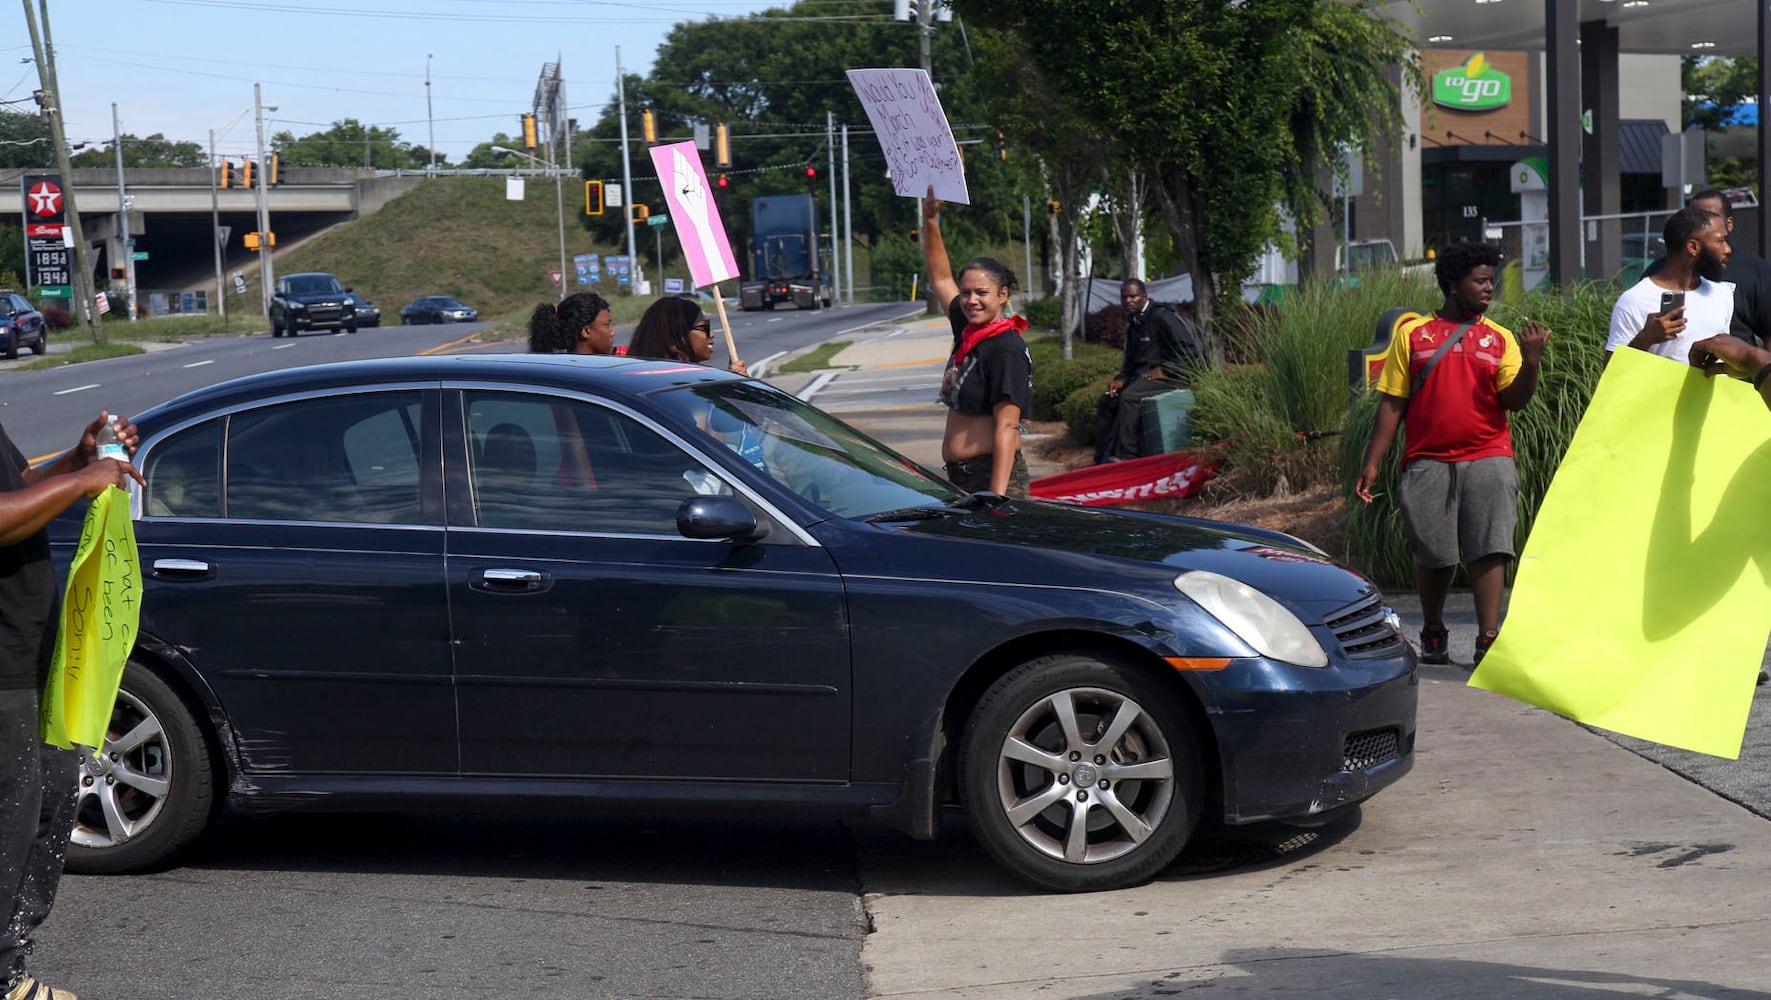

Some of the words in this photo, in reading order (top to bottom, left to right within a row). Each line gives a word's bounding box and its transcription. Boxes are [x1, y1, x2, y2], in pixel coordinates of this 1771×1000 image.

[888, 71, 916, 100] You
[1445, 76, 1465, 87] to
[1460, 79, 1501, 103] go
[105, 539, 117, 570] of
[102, 580, 115, 641] been
